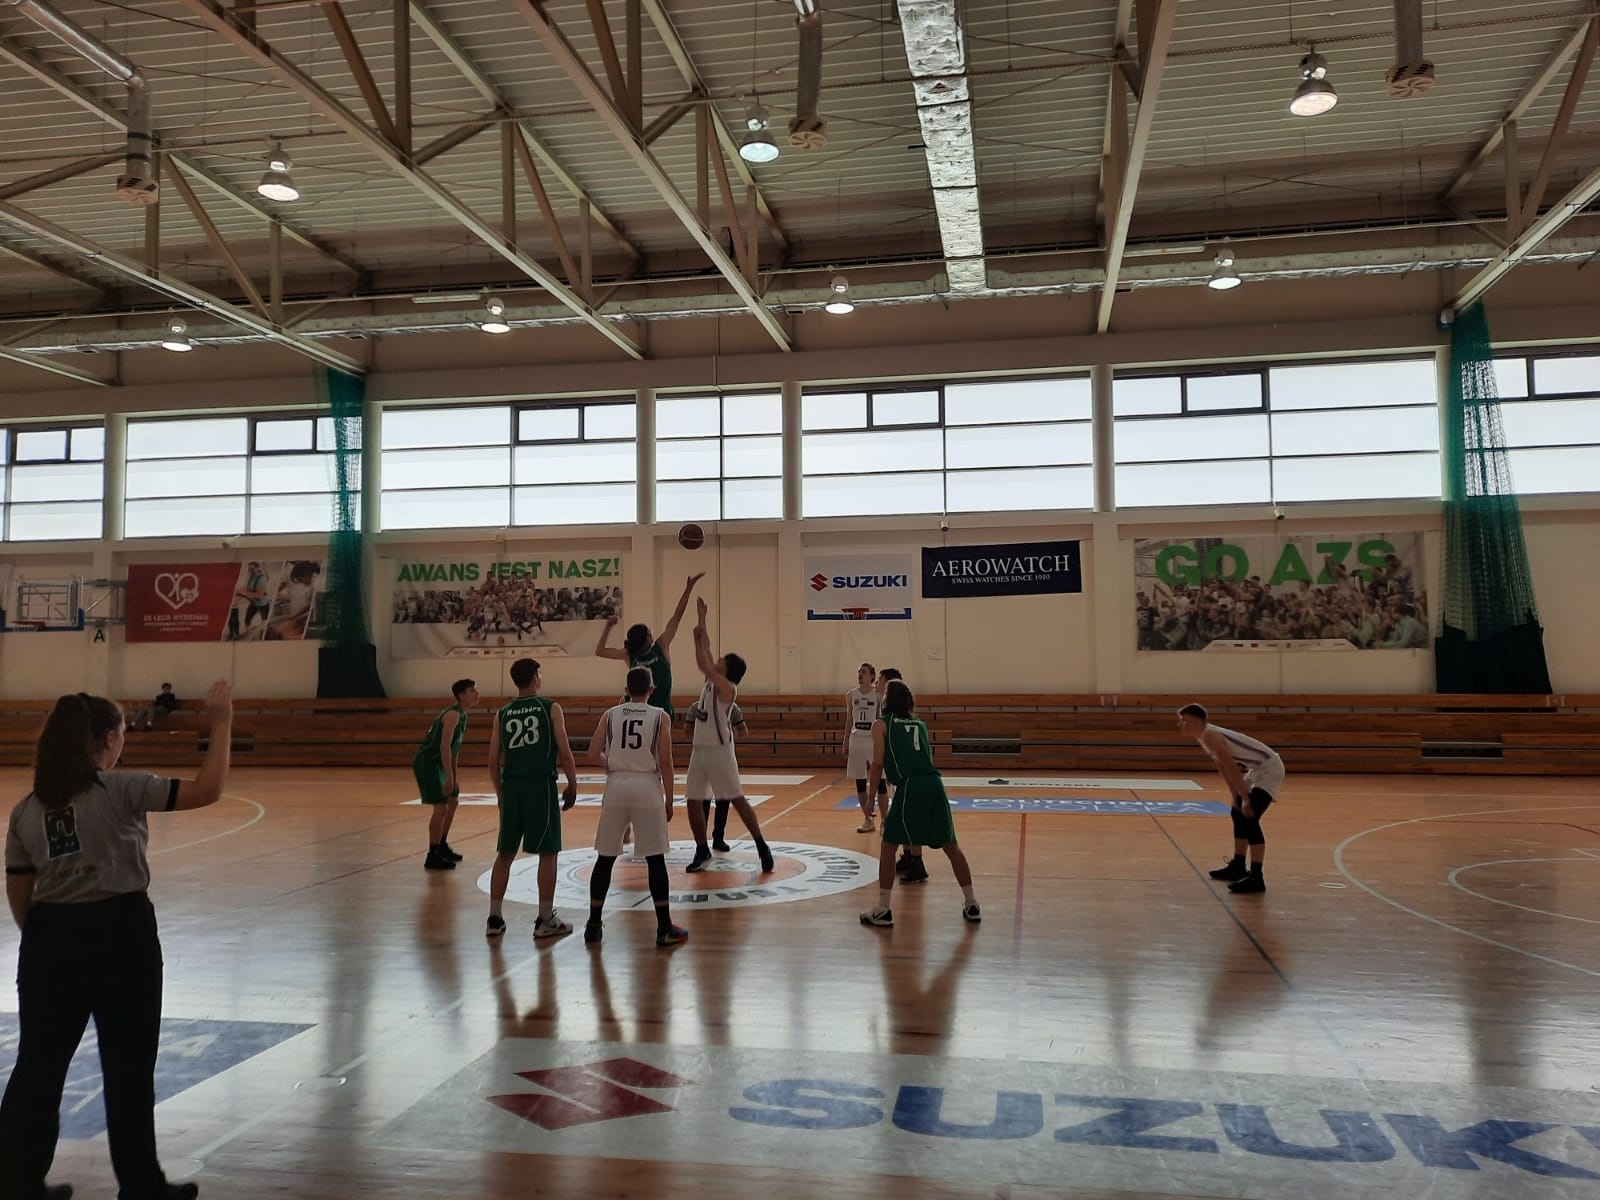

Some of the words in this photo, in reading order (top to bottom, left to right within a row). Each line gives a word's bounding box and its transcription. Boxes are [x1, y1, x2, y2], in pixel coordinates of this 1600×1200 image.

[398, 563, 480, 582] AWANS
[487, 561, 542, 580] JEST
[549, 558, 620, 579] NASZ!
[931, 555, 1070, 577] AEROWATCH
[1155, 544, 1249, 586] GO
[1269, 540, 1397, 586] AZS
[832, 574, 908, 589] SUZUKI
[951, 577, 974, 585] SWISS
[975, 575, 1010, 584] WATCHES
[1010, 574, 1033, 583] SINCE
[1034, 573, 1051, 582] 1910
[93, 628, 106, 644] A
[505, 715, 540, 750] 23
[621, 719, 644, 750] 15
[904, 725, 920, 750] 7
